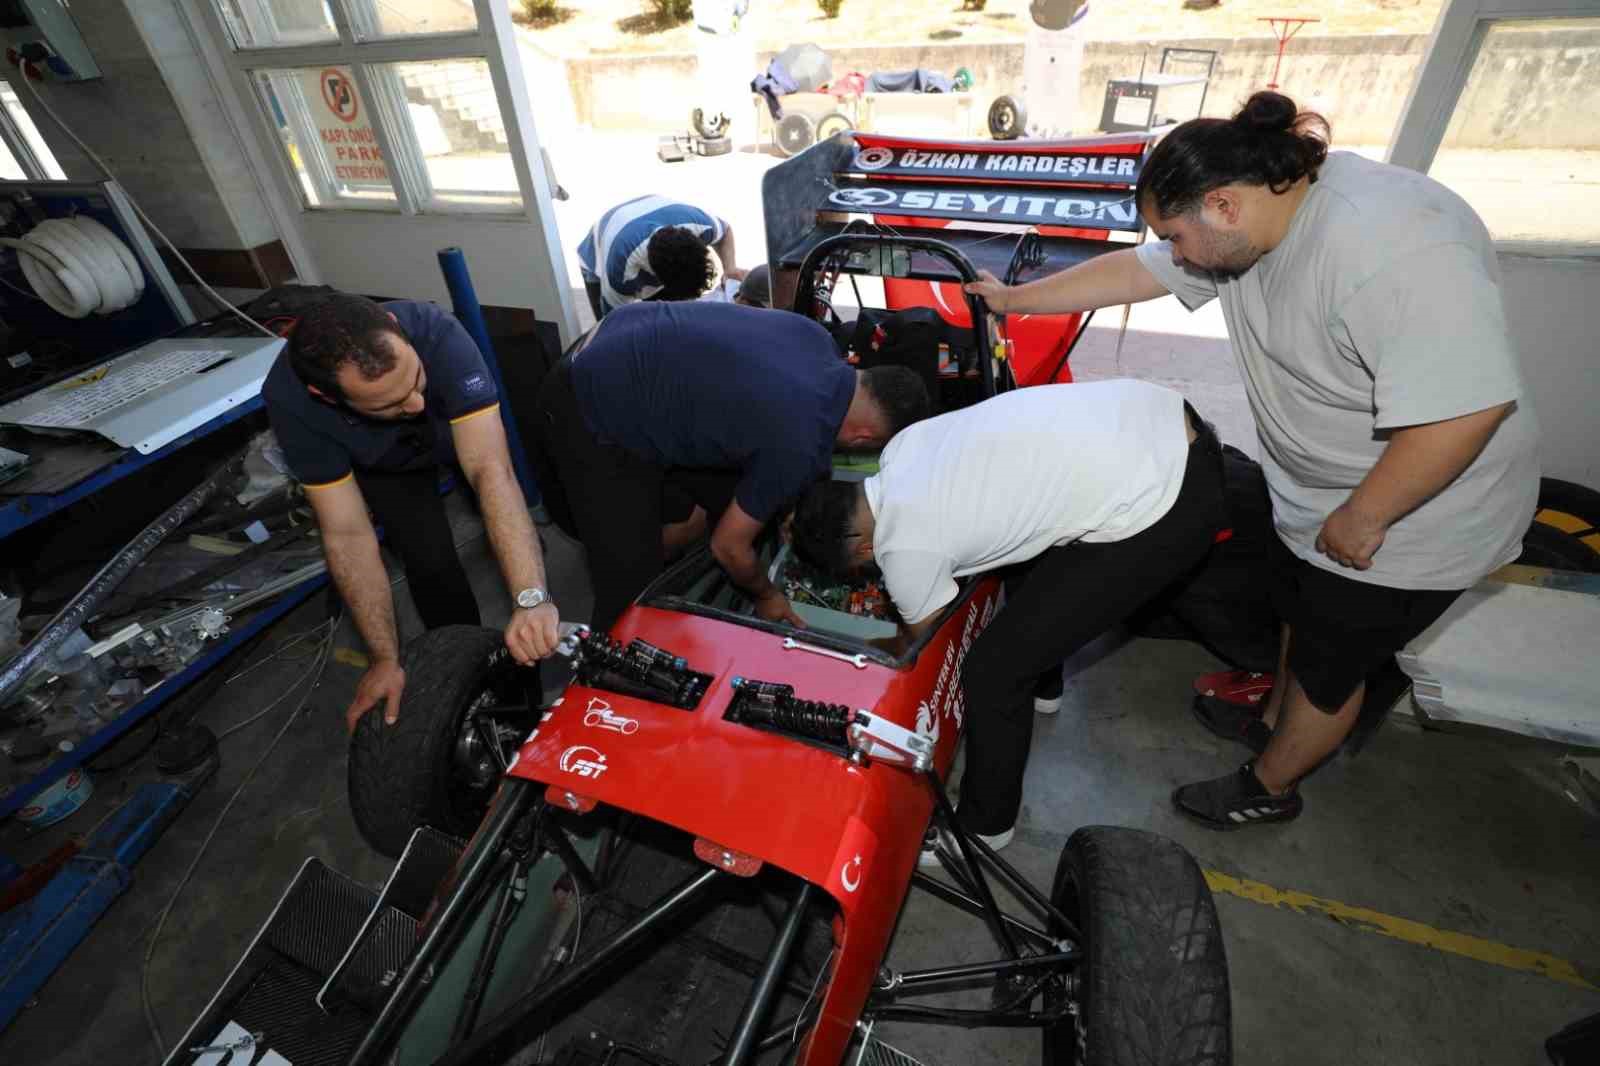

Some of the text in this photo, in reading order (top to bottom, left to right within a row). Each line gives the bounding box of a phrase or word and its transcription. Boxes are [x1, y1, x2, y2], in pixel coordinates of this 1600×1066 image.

[336, 146, 385, 161] PARK
[900, 149, 979, 169] ÖZKAN
[984, 154, 1136, 177] KARDEŞLER
